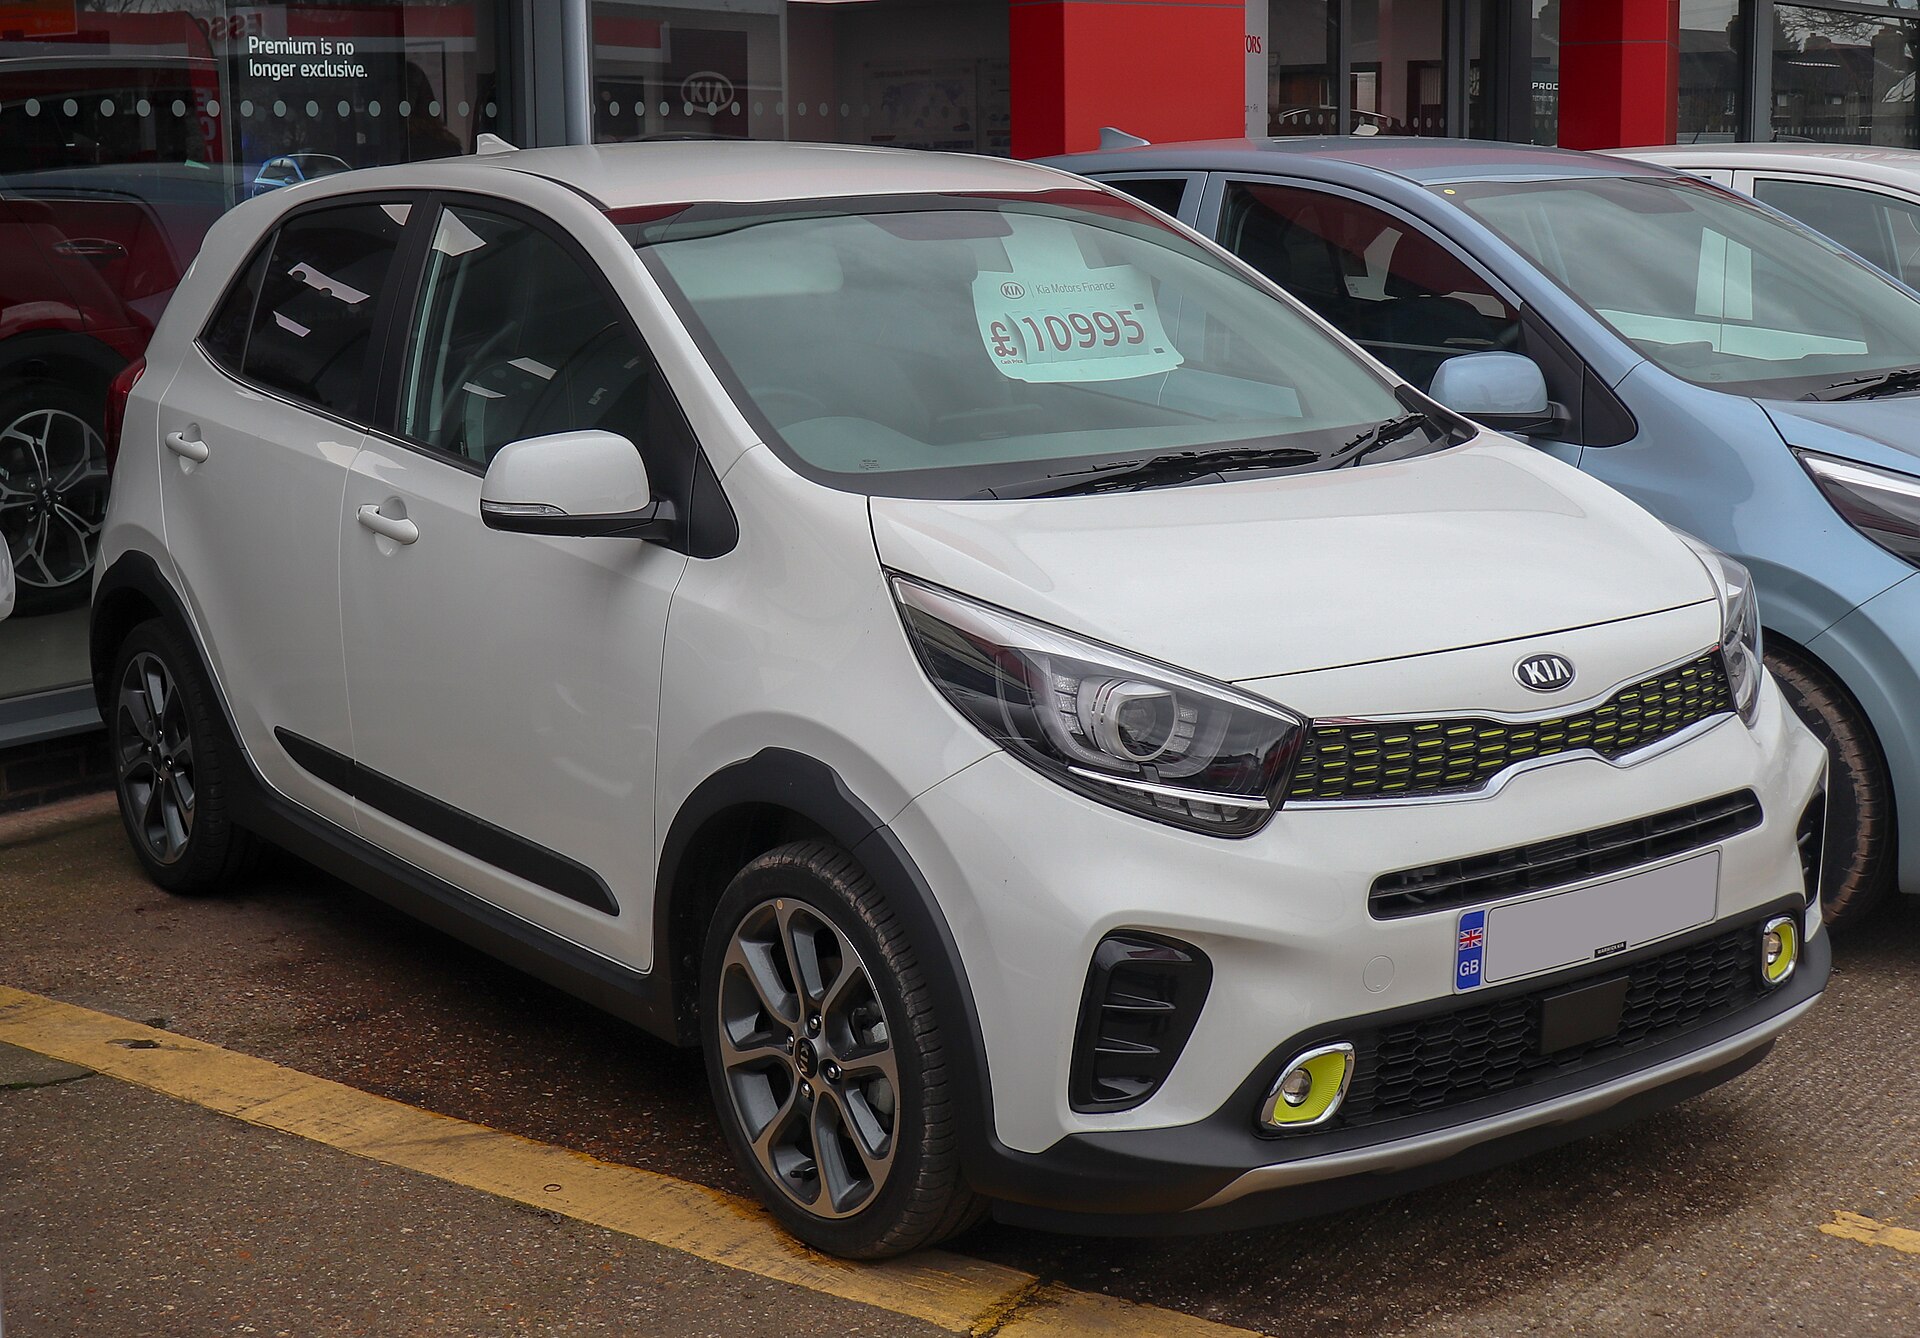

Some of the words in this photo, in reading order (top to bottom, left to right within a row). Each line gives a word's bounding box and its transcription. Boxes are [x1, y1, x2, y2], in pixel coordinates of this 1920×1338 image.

[248, 36, 316, 54] Premium
[320, 37, 332, 55] is
[336, 42, 354, 55] no
[249, 59, 296, 81] longer
[300, 60, 368, 78] exclusive.
[1036, 284, 1050, 295] Kia
[1051, 283, 1081, 294] Motors
[1082, 281, 1116, 292] Finance
[1521, 658, 1571, 685] KIA
[1459, 958, 1479, 977] GB
